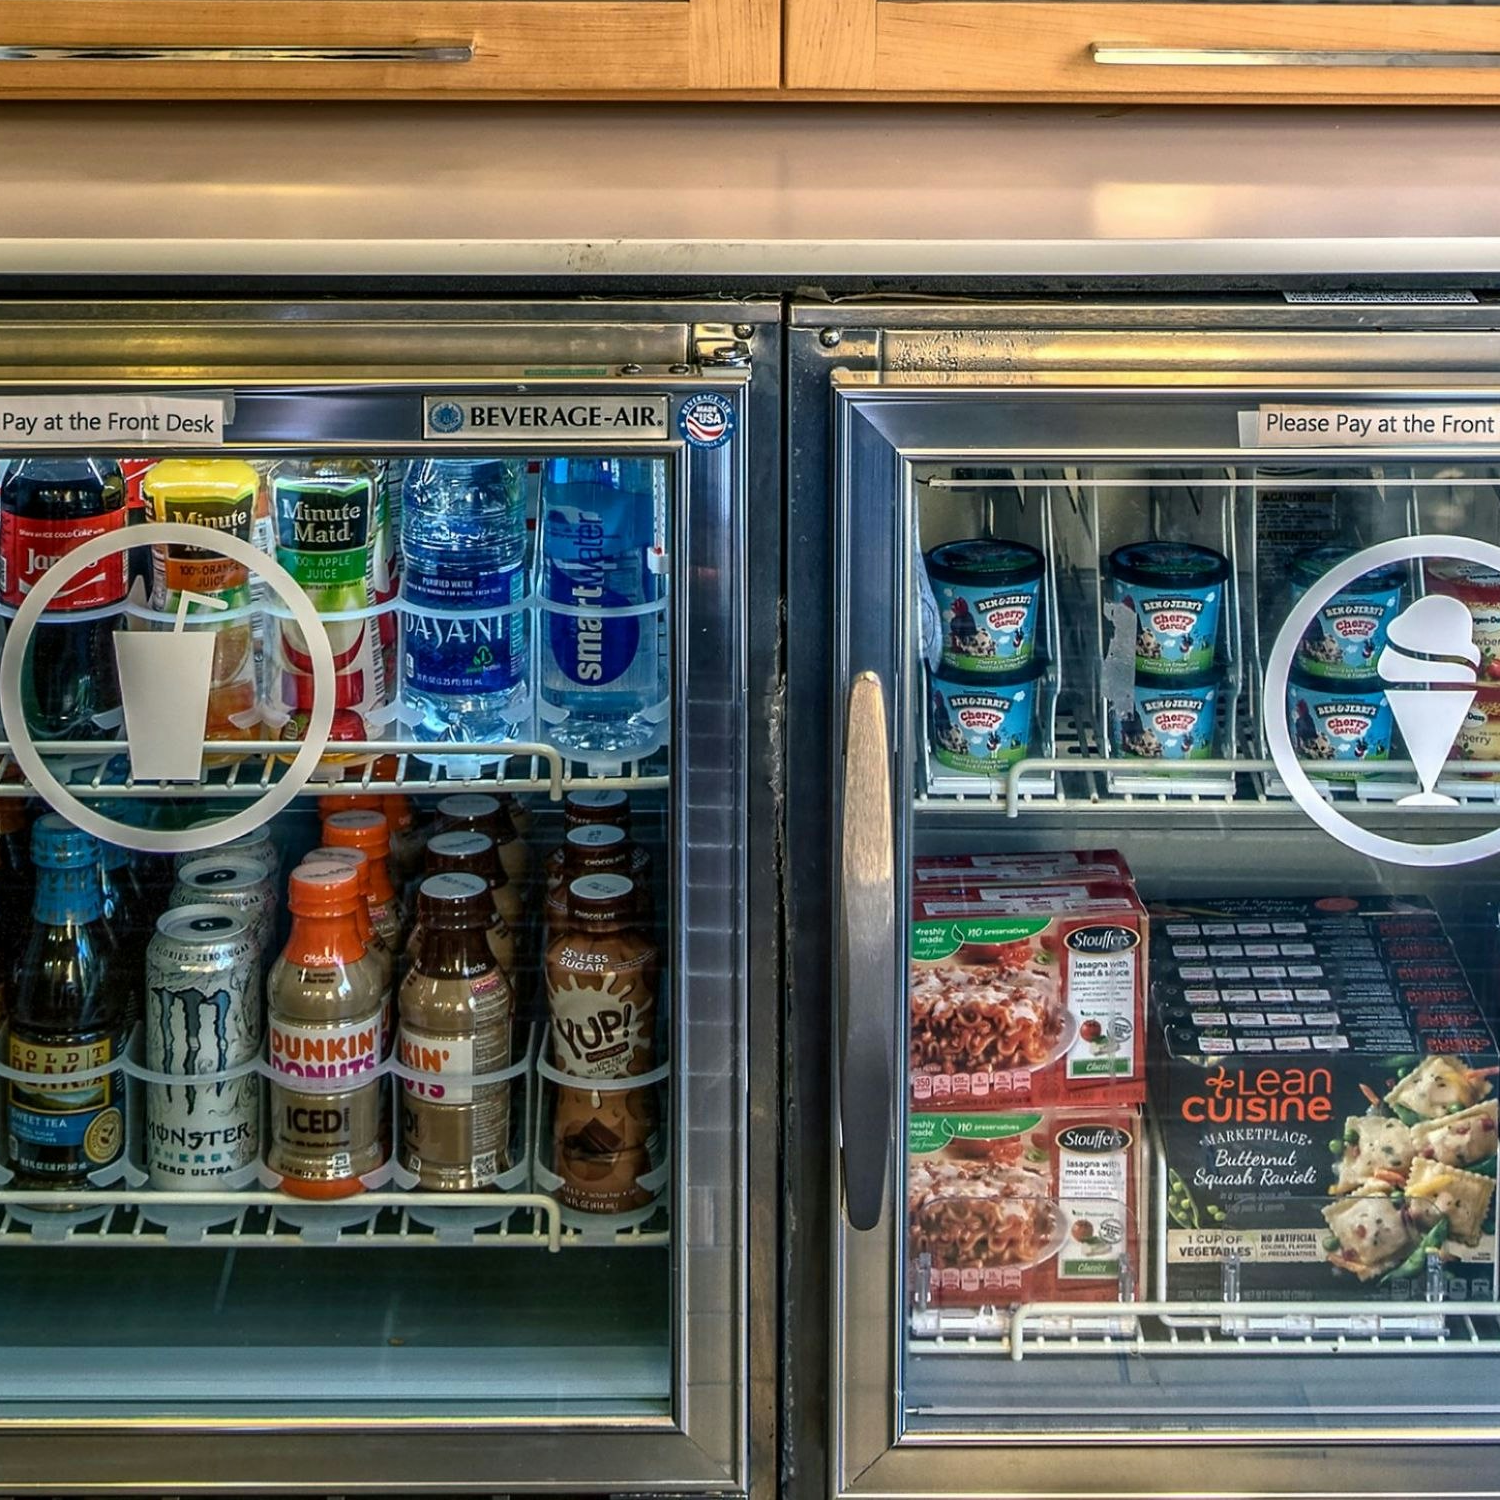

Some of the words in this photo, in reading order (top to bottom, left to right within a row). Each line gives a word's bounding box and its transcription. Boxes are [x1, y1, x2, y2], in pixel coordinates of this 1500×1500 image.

[470, 406, 657, 427] BEVERAGE-AIR
[698, 412, 722, 424] USA
[2, 413, 38, 436] Pay
[43, 415, 63, 431] at
[68, 413, 101, 431] the
[108, 412, 160, 432] Front
[166, 414, 215, 434] Desk
[1266, 413, 1330, 433] Please
[1336, 413, 1372, 437] Pay
[1377, 415, 1398, 433] at
[1403, 414, 1435, 433] the
[1442, 414, 1494, 434] Front
[282, 498, 361, 521] Minute
[293, 521, 351, 543] Maid
[316, 555, 351, 568] APPLE
[199, 562, 241, 576] ORANGE
[305, 567, 338, 580] JUICE
[196, 574, 227, 587] JUICE
[451, 579, 474, 590] WATER
[572, 511, 604, 681] smartwater
[988, 609, 1026, 622] Cherry
[1153, 613, 1196, 625] Cherry
[1335, 618, 1379, 631] Cherry
[915, 927, 946, 938] freshly
[967, 926, 983, 938] no
[919, 935, 944, 944] made
[1073, 930, 1131, 950] Stouffer's
[559, 957, 605, 972] SUGAR
[579, 953, 609, 963] LESS
[1075, 960, 1108, 970] lasagna
[1109, 960, 1129, 969] with
[1073, 969, 1096, 978] meat
[555, 1003, 633, 1060] YUP!
[270, 1026, 379, 1064] DUNKIN'
[1238, 1067, 1332, 1096] Lean
[1181, 1095, 1332, 1123] cuisine
[45, 1118, 67, 1129] TEA
[286, 1106, 343, 1136] ICED
[147, 1121, 252, 1150] MONSTER
[1065, 1130, 1122, 1149] Stouffer's
[1204, 1127, 1308, 1147] MARKETPLACE
[1214, 1147, 1297, 1167] Butternut
[156, 1164, 187, 1176] ZERO
[190, 1164, 233, 1177] ULTRA
[1066, 1160, 1100, 1170] lasagna
[1193, 1167, 1256, 1186] Squash
[1260, 1167, 1317, 1186] Ravioli
[1196, 1235, 1222, 1245] CUP
[1225, 1235, 1244, 1245] OF
[1260, 1233, 1273, 1243] NO
[1274, 1233, 1317, 1243] ARTIFICIAL
[1179, 1246, 1252, 1258] VEGETABLES
